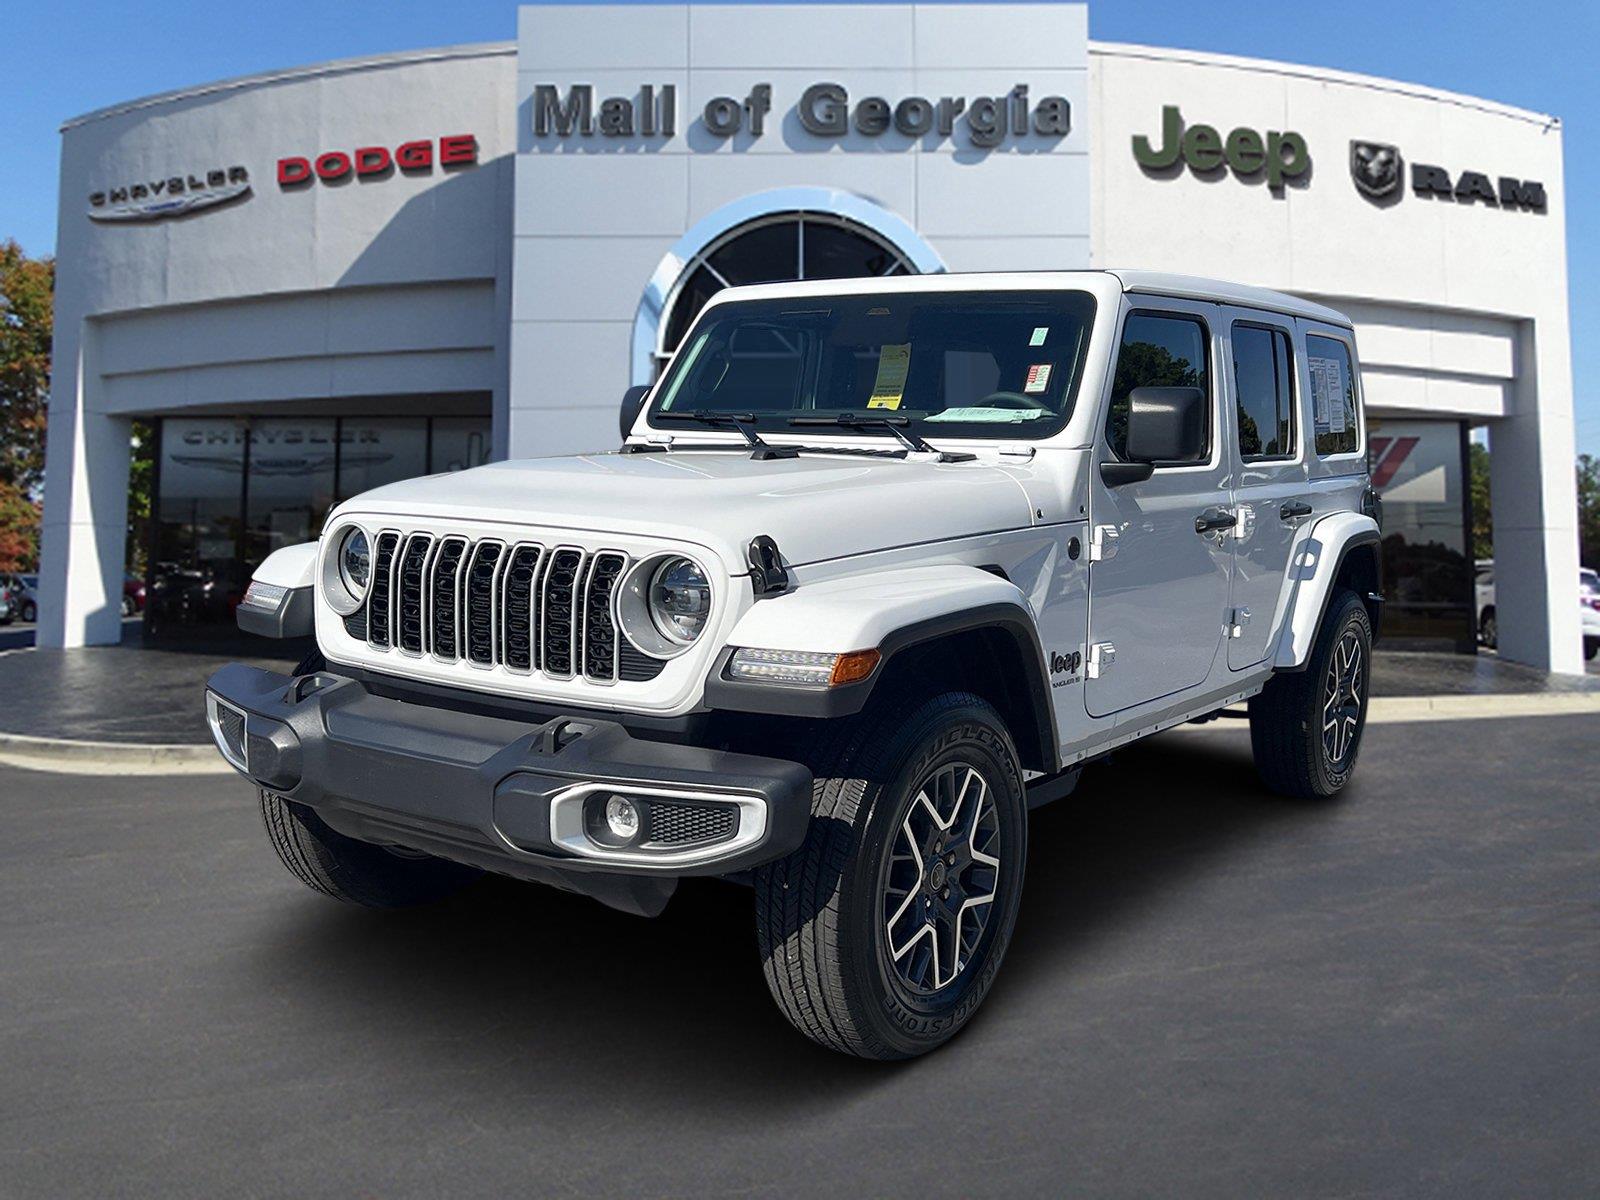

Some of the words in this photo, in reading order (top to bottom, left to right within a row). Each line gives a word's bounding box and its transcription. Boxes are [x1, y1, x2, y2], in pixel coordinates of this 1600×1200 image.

[532, 84, 676, 137] Mall
[702, 83, 773, 136] of
[799, 83, 1073, 148] Georgia
[277, 134, 477, 186] DODGE
[1132, 105, 1308, 189] Jeep
[89, 165, 248, 207] CHRYSLER
[1410, 163, 1547, 212] RAM
[182, 429, 381, 445] CHRYSLER
[1050, 651, 1081, 675] Jeep
